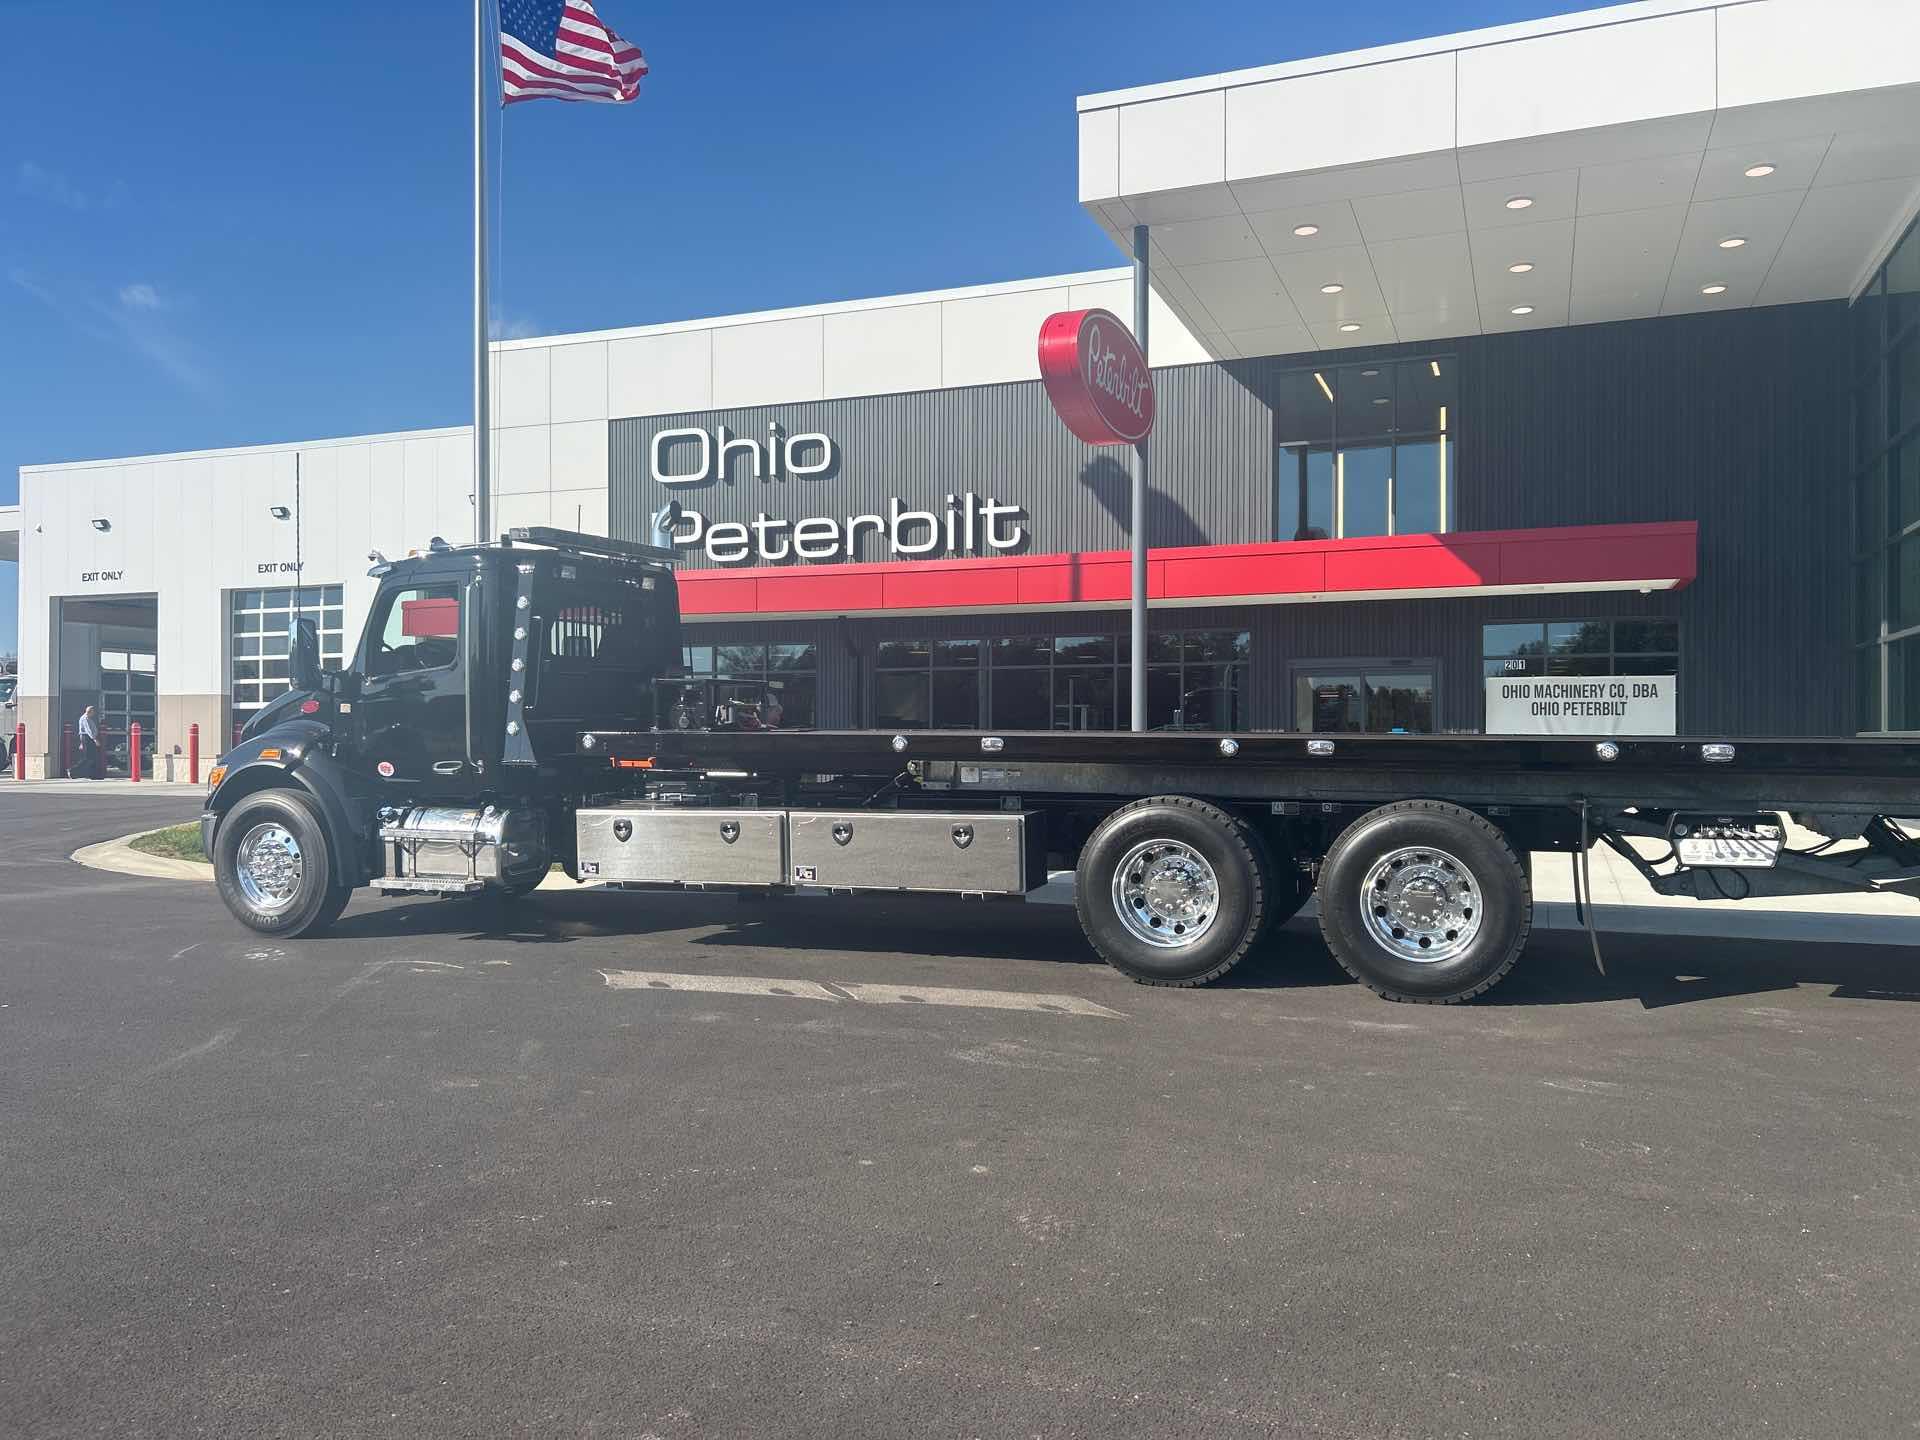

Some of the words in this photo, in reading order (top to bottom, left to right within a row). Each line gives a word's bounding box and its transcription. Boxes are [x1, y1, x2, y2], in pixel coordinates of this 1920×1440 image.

[1087, 323, 1149, 418] Peterbilt
[651, 421, 832, 483] Ohio
[257, 563, 278, 573] EXIT
[280, 561, 304, 572] ONLY
[82, 572, 99, 582] EXIT
[101, 570, 123, 581] ONLY
[1505, 659, 1526, 670] 201
[1502, 684, 1530, 699] OHIO
[1534, 683, 1605, 699] MACHINERY
[1609, 683, 1628, 700] CO,
[1633, 683, 1658, 698] DBA
[1531, 701, 1559, 716] OHIO
[1563, 701, 1627, 716] PETERBILT
